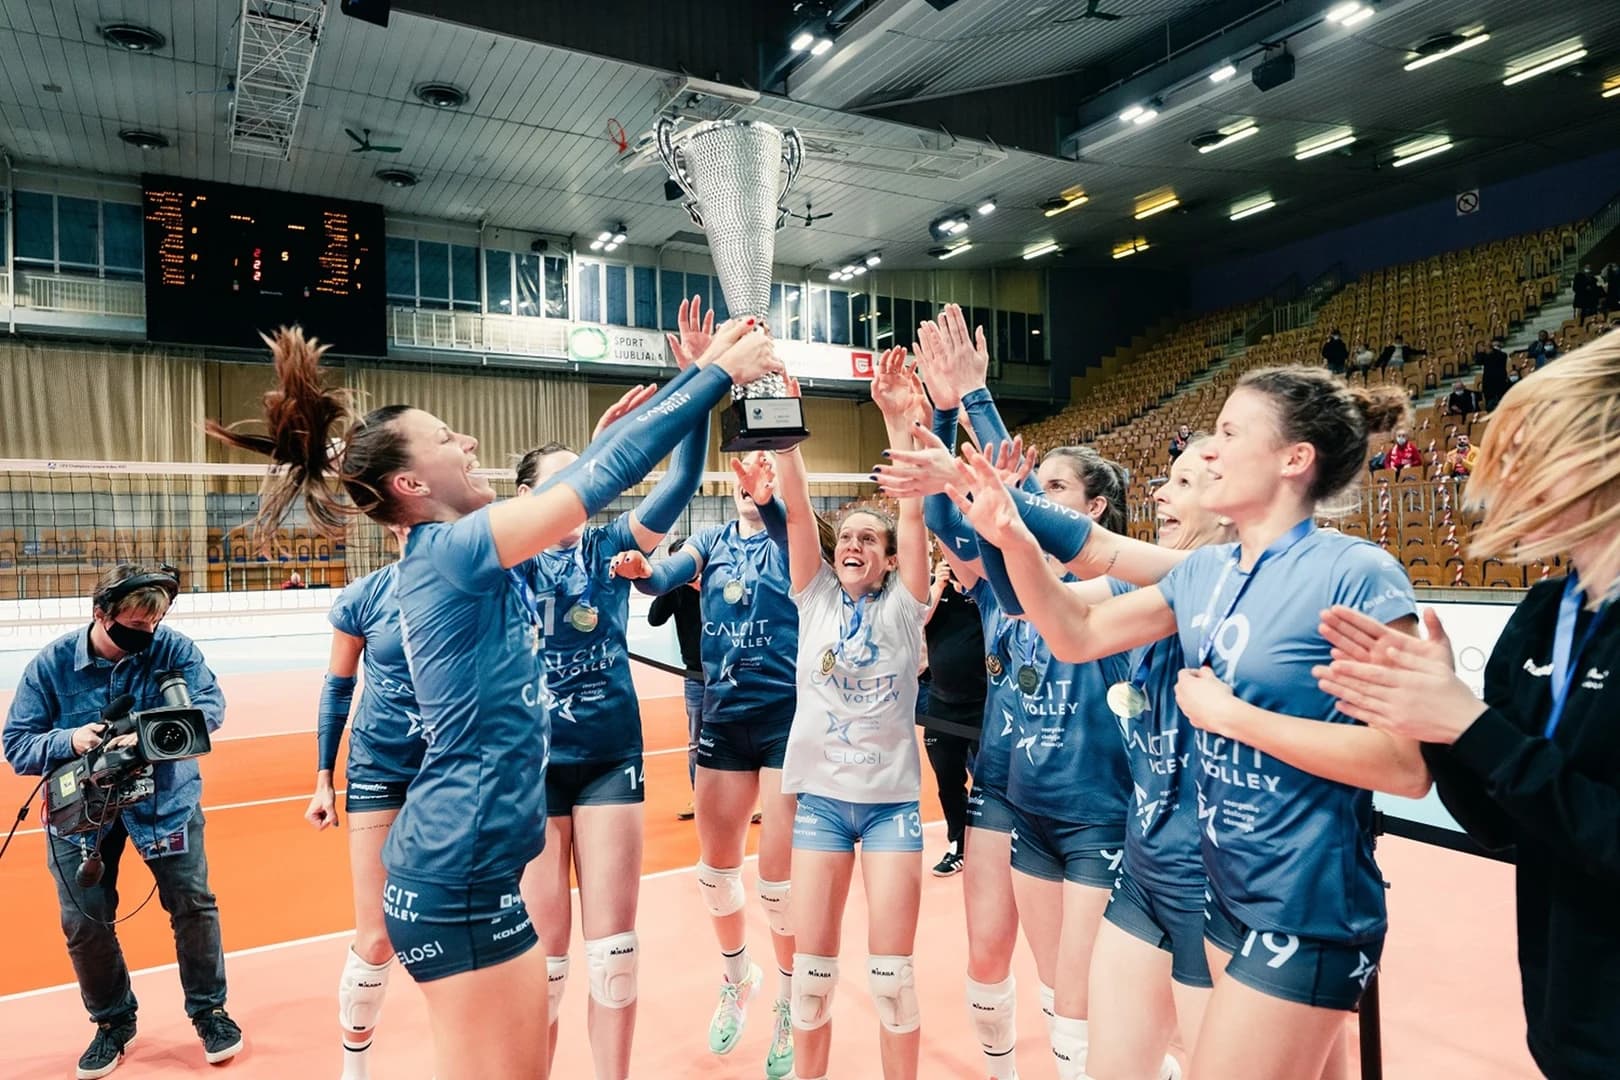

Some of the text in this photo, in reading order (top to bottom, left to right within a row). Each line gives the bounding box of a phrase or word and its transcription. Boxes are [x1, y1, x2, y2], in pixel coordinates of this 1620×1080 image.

[253, 260, 261, 270] 2
[253, 271, 261, 281] 2
[614, 336, 644, 348] SPORT
[664, 393, 691, 416] VOLLEY
[1024, 491, 1080, 520] CALCIT
[703, 619, 769, 638] CALCIT
[556, 656, 616, 679] VOLLEY
[810, 673, 898, 692] CALCIT
[1022, 702, 1079, 716] VOLLEY
[1201, 758, 1280, 793] VOLLEY
[893, 811, 922, 839] 13
[384, 900, 420, 922] OLLEY
[1241, 929, 1300, 969] 19
